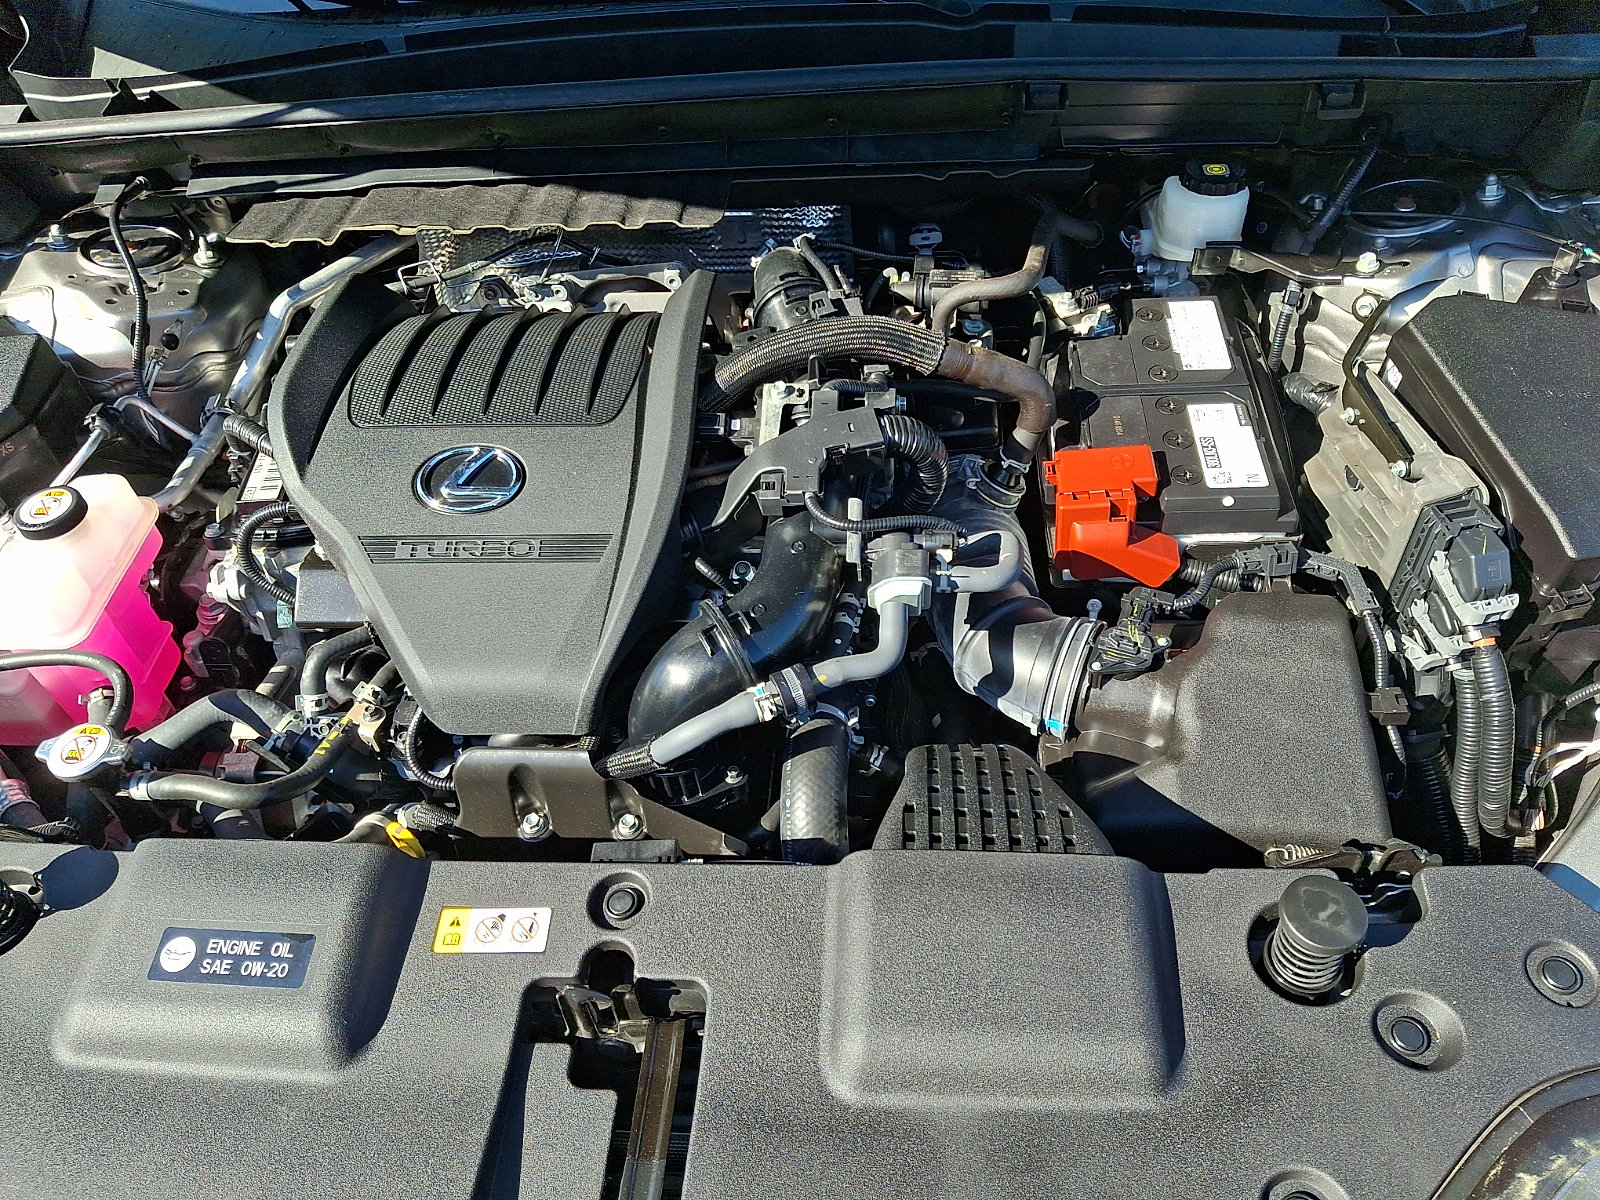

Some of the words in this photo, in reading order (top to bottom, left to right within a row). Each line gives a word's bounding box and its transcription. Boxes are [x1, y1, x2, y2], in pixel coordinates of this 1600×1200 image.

[401, 539, 536, 558] TURBO
[206, 938, 264, 956] ENGINE
[270, 941, 294, 958] OIL
[200, 959, 234, 975] SAE
[241, 962, 289, 978] 0W-20
